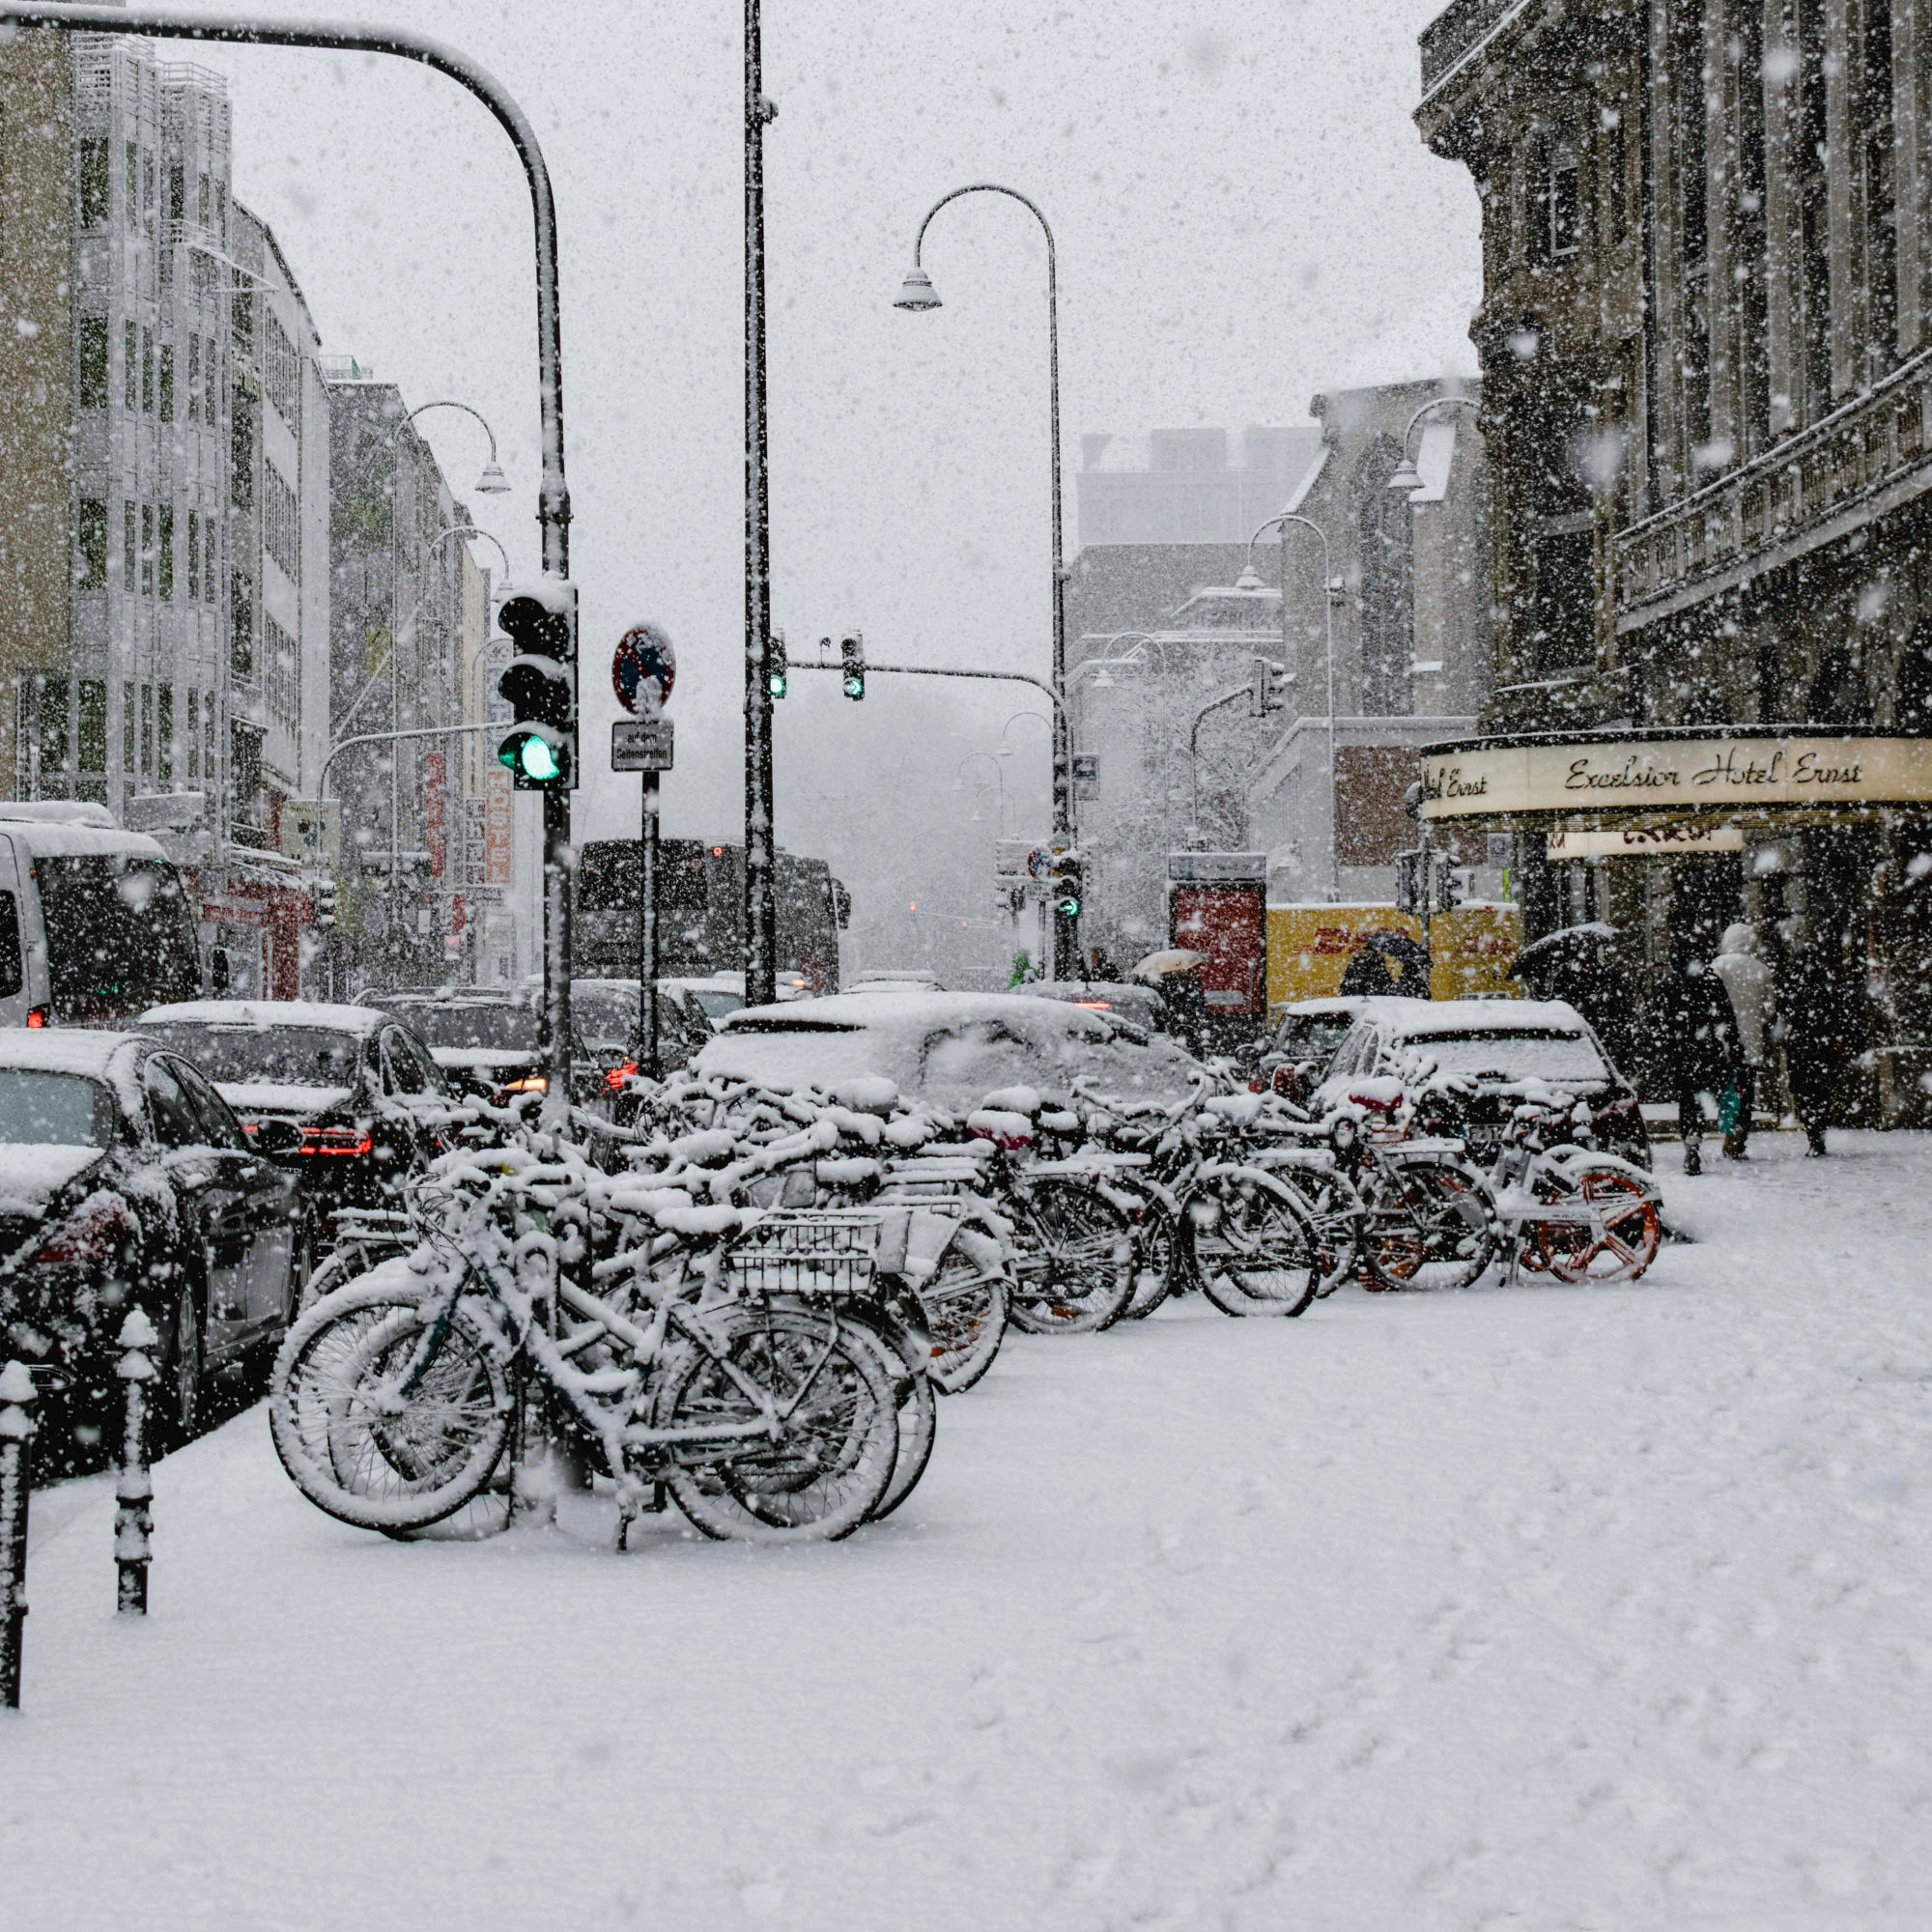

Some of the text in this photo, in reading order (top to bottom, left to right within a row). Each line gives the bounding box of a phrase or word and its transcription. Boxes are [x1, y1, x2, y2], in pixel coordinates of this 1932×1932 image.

[627, 731, 658, 743] auf dem
[616, 748, 668, 759] Seitenstreifen
[1564, 745, 1863, 789] Excelsior Hotel Ernst
